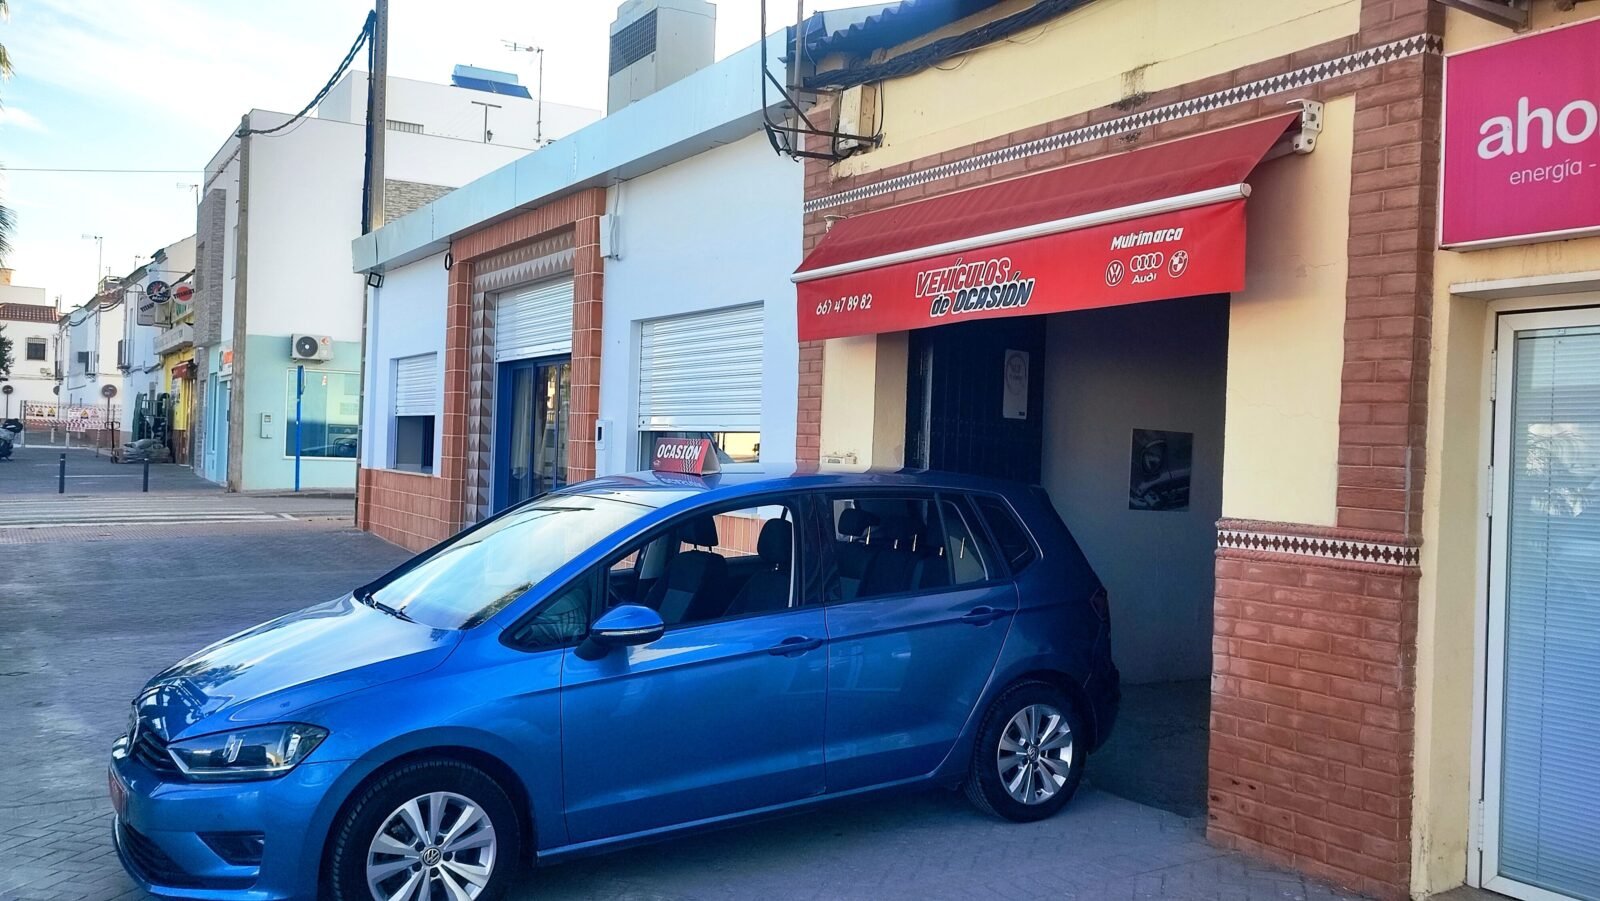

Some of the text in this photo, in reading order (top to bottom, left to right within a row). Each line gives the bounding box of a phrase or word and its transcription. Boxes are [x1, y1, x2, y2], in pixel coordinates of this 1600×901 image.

[1477, 96, 1600, 160] aho
[1509, 158, 1583, 185] energía
[915, 257, 1012, 298] VEHÍCULOS
[929, 271, 1035, 317] de OCASIÓN
[1131, 272, 1157, 285] Audi
[834, 296, 847, 313] 47
[847, 295, 859, 311] 89
[860, 293, 873, 310] 82
